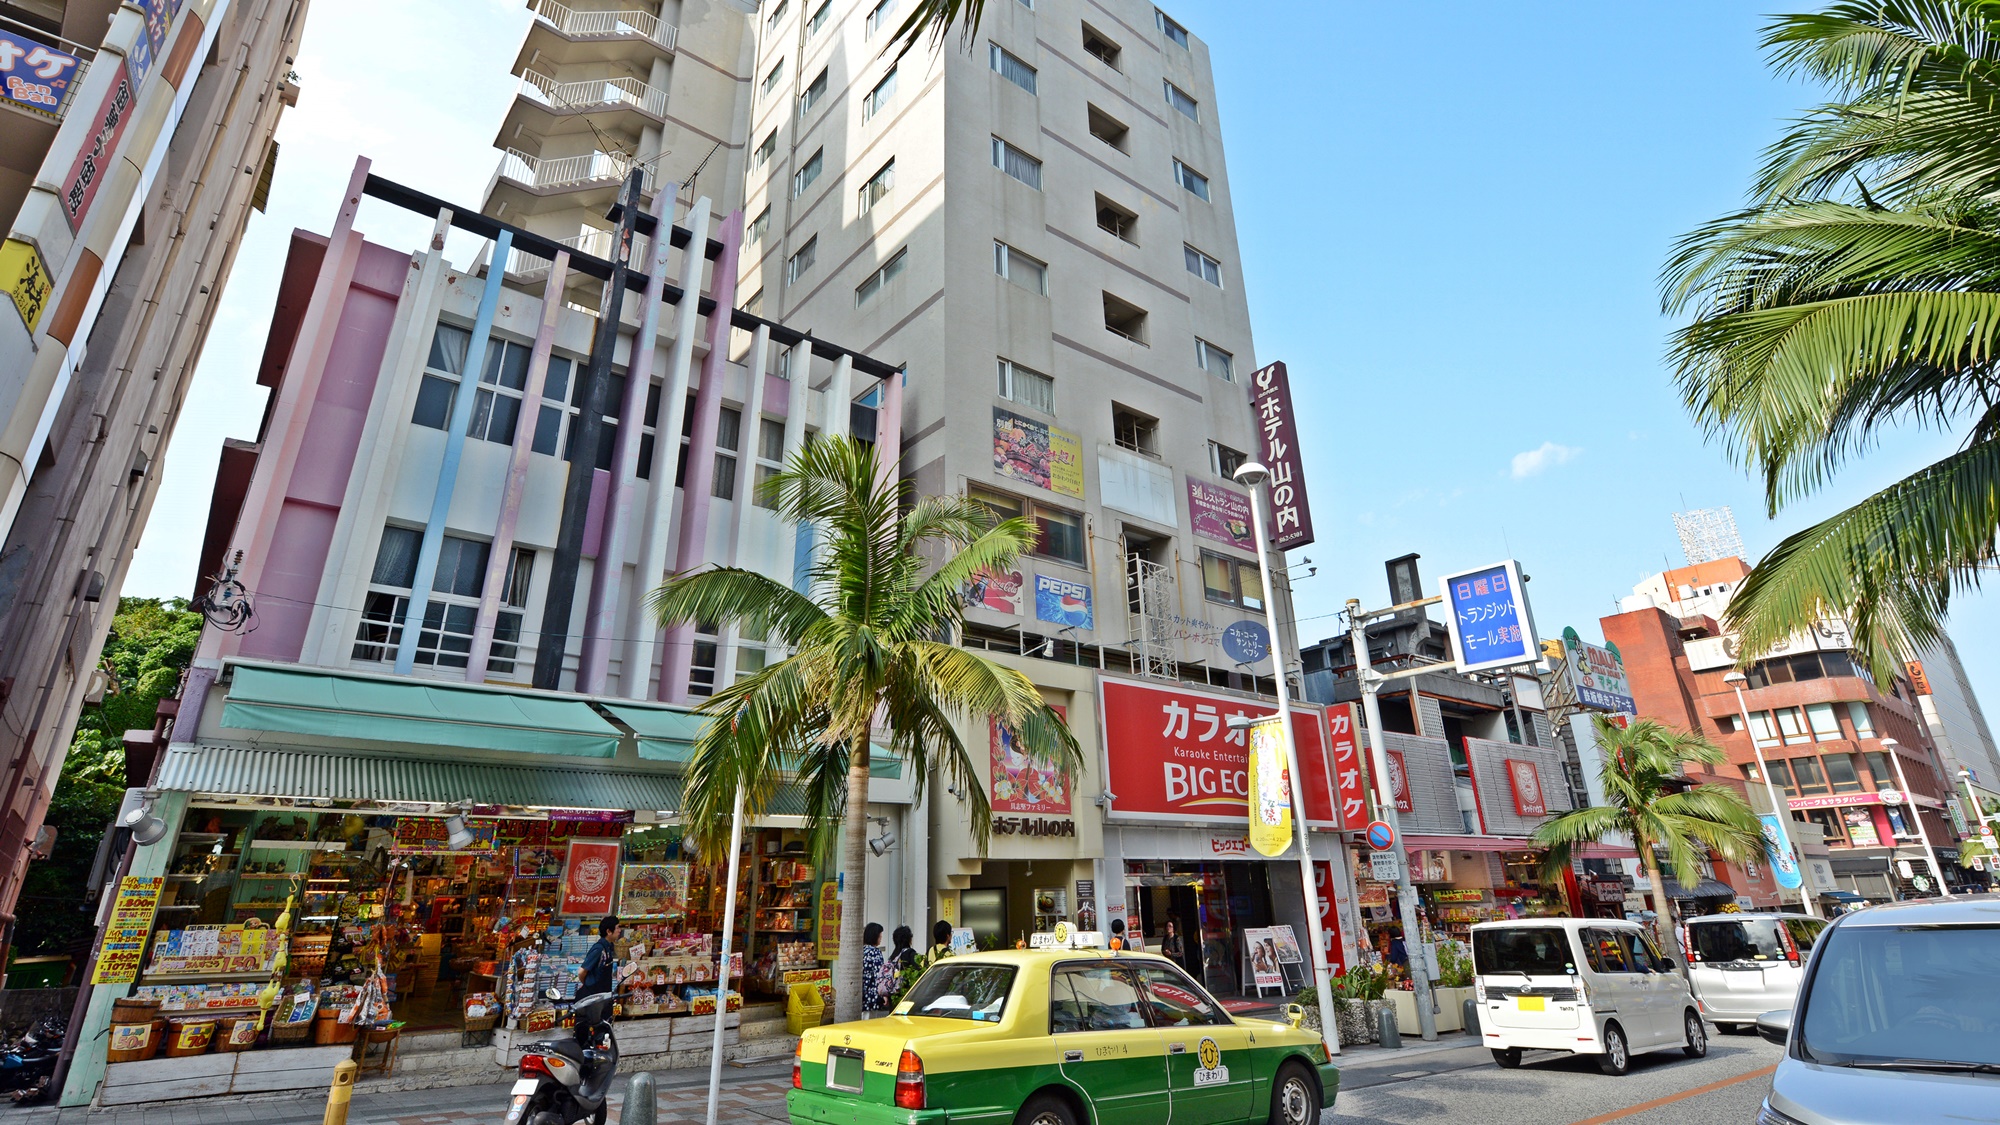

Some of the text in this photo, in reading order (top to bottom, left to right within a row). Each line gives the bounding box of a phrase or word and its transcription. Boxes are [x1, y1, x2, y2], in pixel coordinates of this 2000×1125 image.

[7, 76, 52, 95] Ban
[13, 87, 57, 105] Ban
[1260, 397, 1300, 534] ホテル山の内
[1038, 577, 1087, 600] PEPSI
[1457, 573, 1507, 601] 日曜日
[1458, 599, 1516, 626] トランジット
[1236, 638, 1263, 649] サントリー
[1466, 624, 1523, 650] モール実施
[1587, 646, 1618, 670] MAUI
[1598, 675, 1621, 695] マウイ
[1582, 689, 1633, 711] 鉄板焼きステーキ
[1173, 746, 1210, 760] Karaoke
[1331, 714, 1364, 819] カラオケ
[1163, 762, 1218, 802] BIG
[992, 816, 1075, 837] ホテル山の内
[568, 895, 606, 903] キッドハウス
[1032, 935, 1054, 945] ひまわり
[1249, 1031, 1256, 1044] 4
[1199, 1071, 1224, 1082] ひまわり
